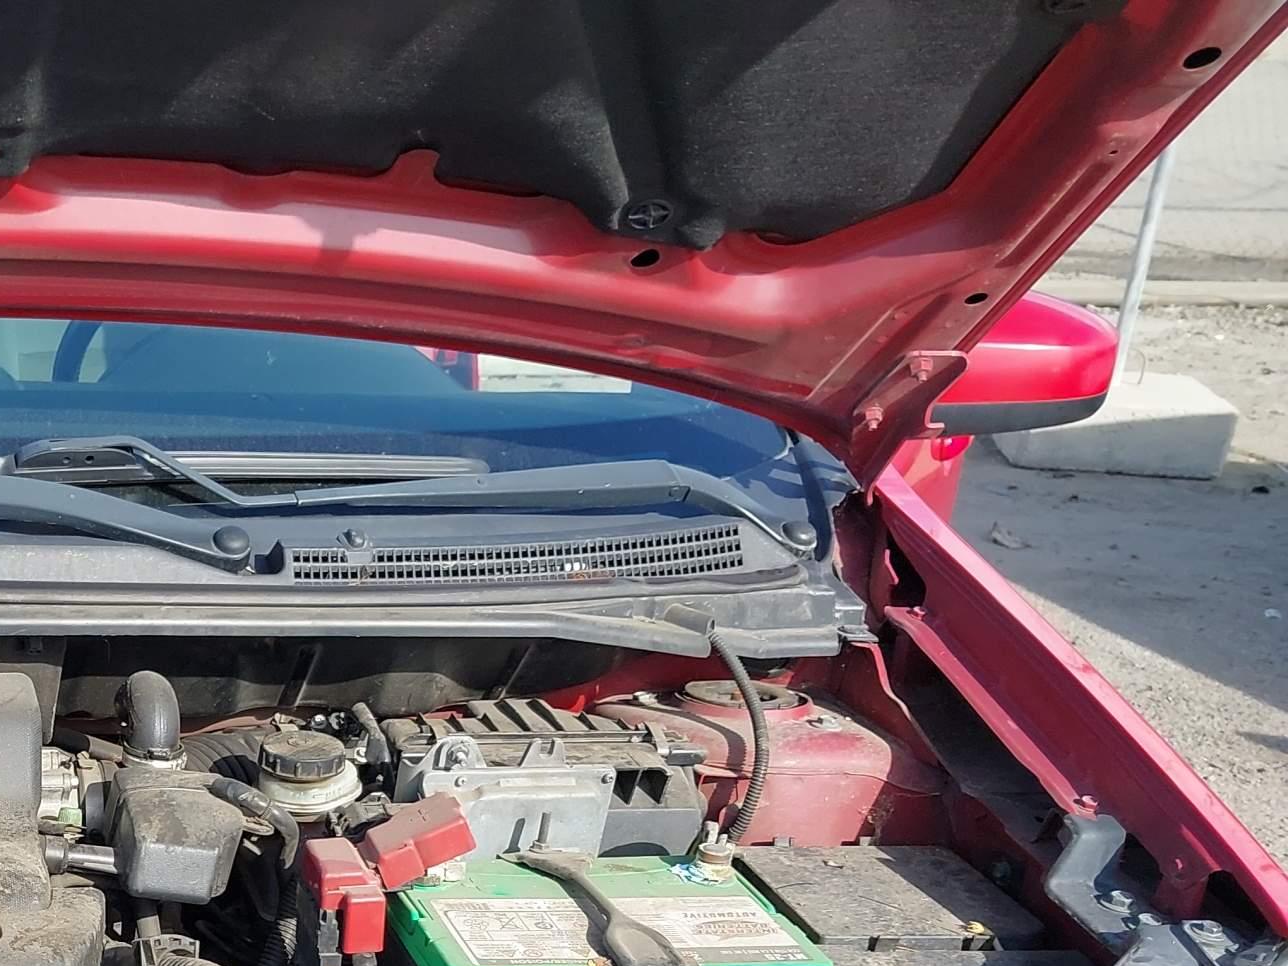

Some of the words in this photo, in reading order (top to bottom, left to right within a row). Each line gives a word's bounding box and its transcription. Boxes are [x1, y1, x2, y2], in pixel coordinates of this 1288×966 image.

[682, 911, 757, 919] AUTOMOTIVE
[695, 922, 770, 930] BATTERIES
[691, 927, 778, 935] INTERSTATE
